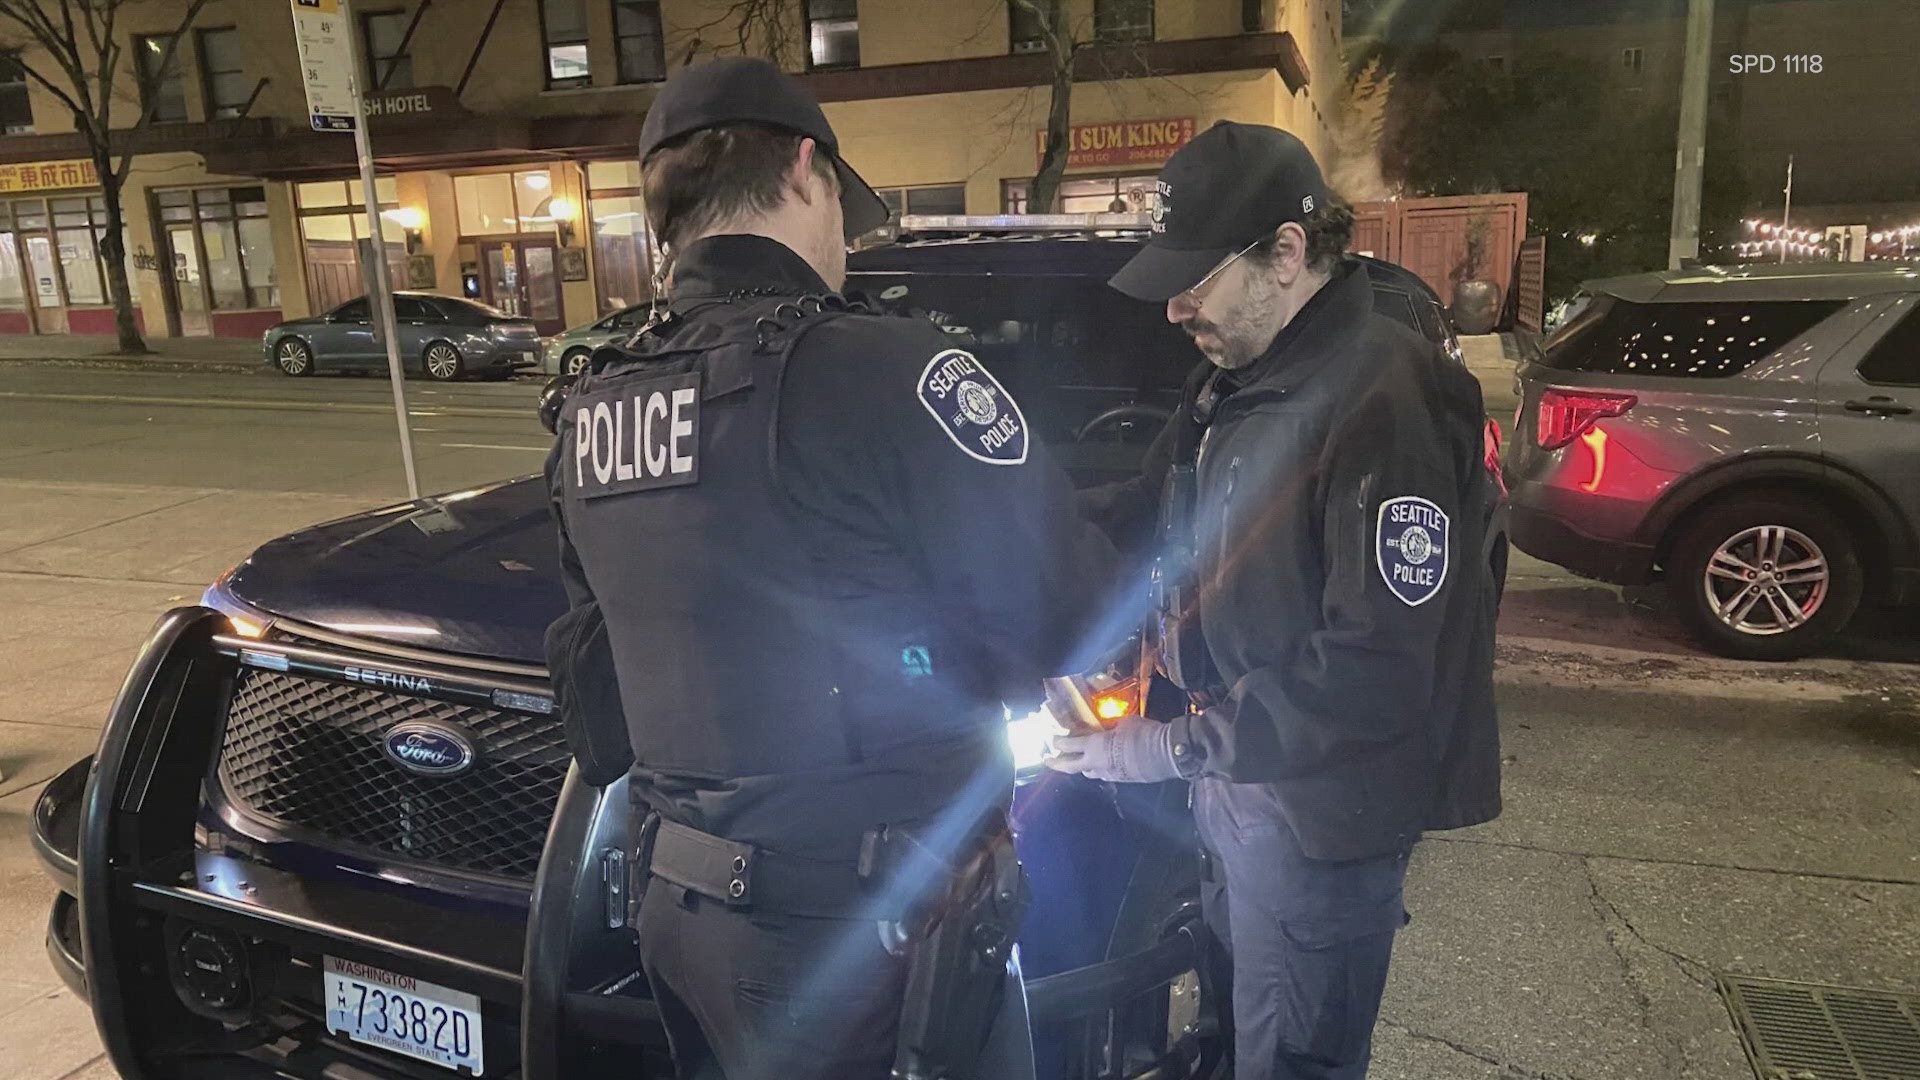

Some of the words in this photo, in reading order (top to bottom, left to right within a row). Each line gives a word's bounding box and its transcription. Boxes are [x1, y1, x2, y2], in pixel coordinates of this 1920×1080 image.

[308, 70, 318, 80] 36
[362, 99, 382, 116] SH
[386, 95, 432, 114] HOTEL
[1080, 125, 1123, 151] SUM
[1127, 121, 1180, 147] KING
[928, 356, 976, 399] SEATTLE
[576, 388, 695, 488] POLICE
[979, 413, 1020, 454] POLICE
[1390, 504, 1441, 532] SEATTLE
[1393, 563, 1434, 586] POLICE
[344, 666, 433, 694] SETINA
[396, 733, 453, 764] Ford
[334, 959, 417, 992] WASHINGTON
[351, 982, 471, 1058] 73382D
[367, 1032, 413, 1052] EVERGREEN
[416, 1045, 441, 1061] STATE
